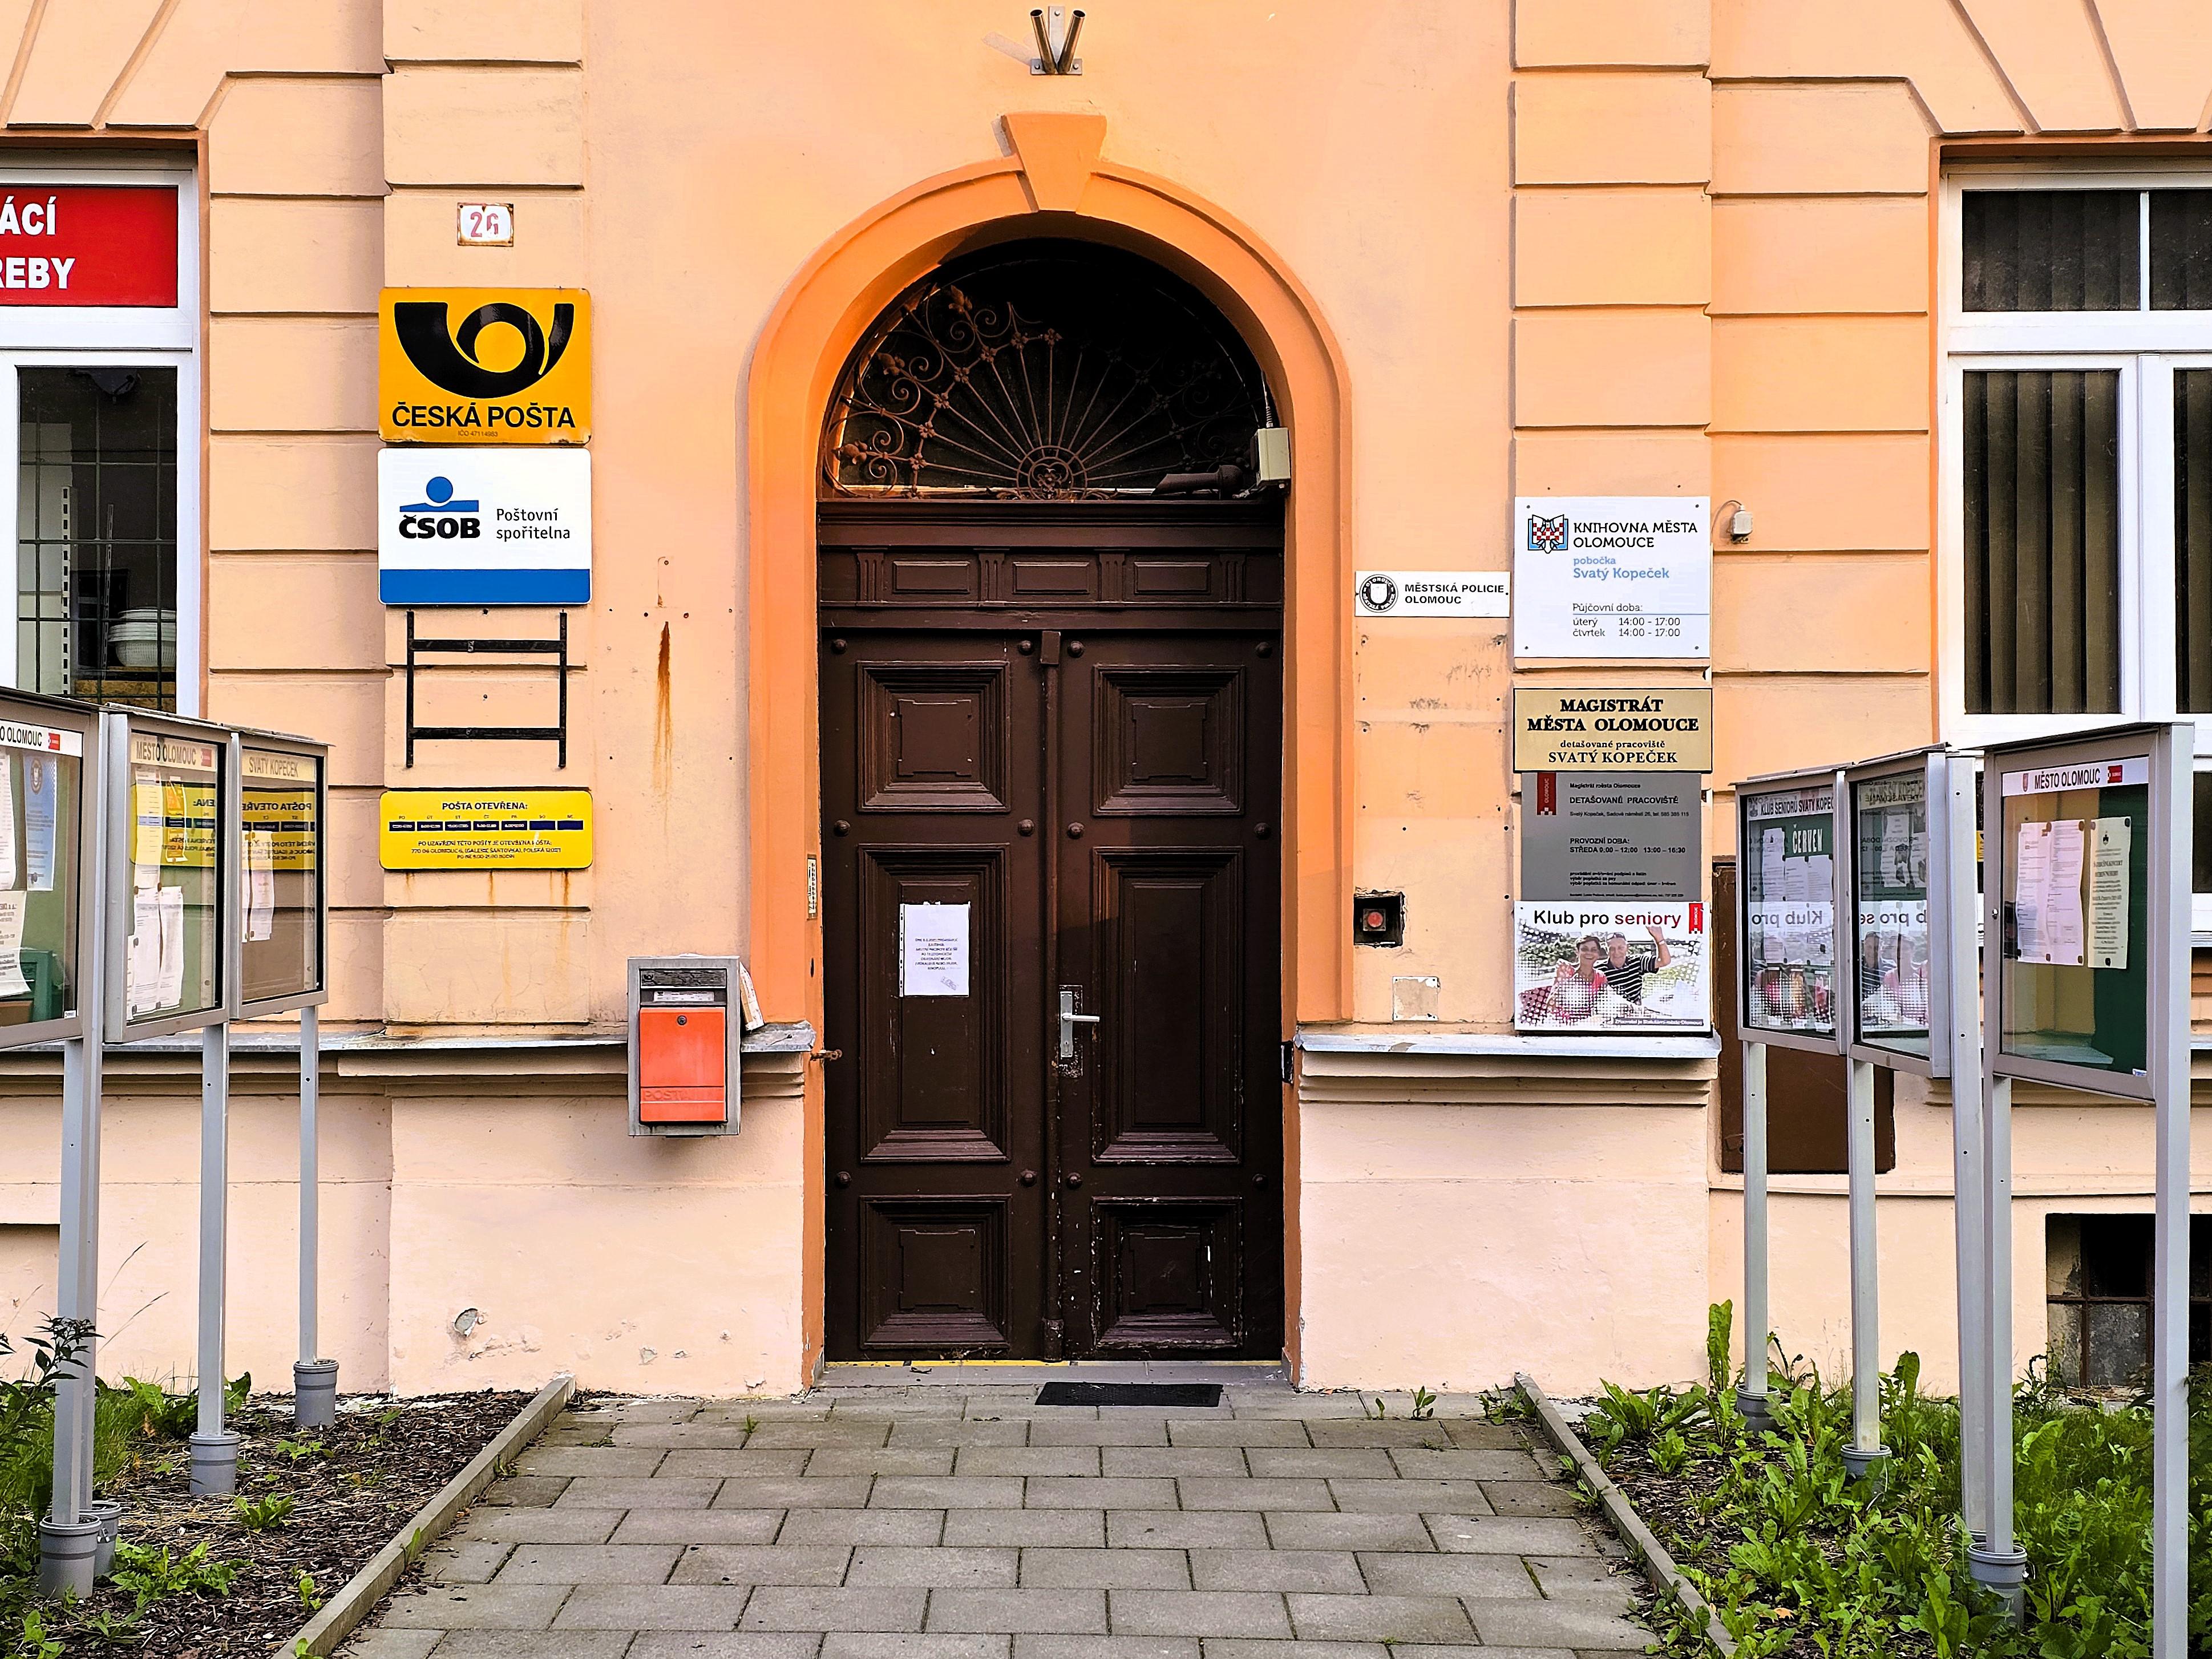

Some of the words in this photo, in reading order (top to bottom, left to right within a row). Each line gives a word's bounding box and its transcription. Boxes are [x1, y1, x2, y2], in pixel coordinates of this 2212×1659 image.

[0, 257, 75, 289] EBY
[393, 402, 481, 427] ČESKÁ
[488, 402, 575, 427] POŠTA
[496, 508, 558, 521] Poštovní
[399, 515, 480, 539] ČSOB
[496, 526, 570, 542] spořitelna
[1574, 522, 1648, 533] KNIHOVNA
[1653, 520, 1698, 533] MĚSTA
[1574, 537, 1654, 548] OLOMOUCE
[1574, 556, 1616, 565] pobočka
[1574, 568, 1610, 580] Svatý
[1613, 568, 1669, 580] Kopeček
[1405, 582, 1458, 592] MĚSTSKÁ
[1573, 603, 1613, 613] Půjčovní
[1617, 603, 1643, 612] doba:
[1573, 618, 1598, 627] úterý
[1560, 696, 1663, 712] MAGISTRÁT
[1527, 715, 1586, 731] MĚSTA
[1595, 718, 1699, 731] OLOMOUCE
[7, 727, 42, 746] OLOMOUC
[136, 741, 160, 761] MĚSTO
[163, 745, 196, 765] OLOMOUC
[1616, 740, 1665, 750] pracoviště
[1548, 750, 1598, 763] SVATÝ
[1602, 750, 1677, 763] KOPEČEK
[2035, 771, 2059, 789] MĚSTO
[2061, 768, 2100, 787] OLOMOUC
[442, 802, 472, 810] POŠTA
[475, 801, 528, 810] OTEVŘENA:
[1761, 803, 1773, 815] KLUB
[1799, 795, 1814, 812] SVATÝ
[1793, 824, 1823, 853] ČERVEN
[1534, 911, 1574, 924] Klub
[1580, 913, 1609, 928] pro
[1615, 911, 1681, 928] seniory
